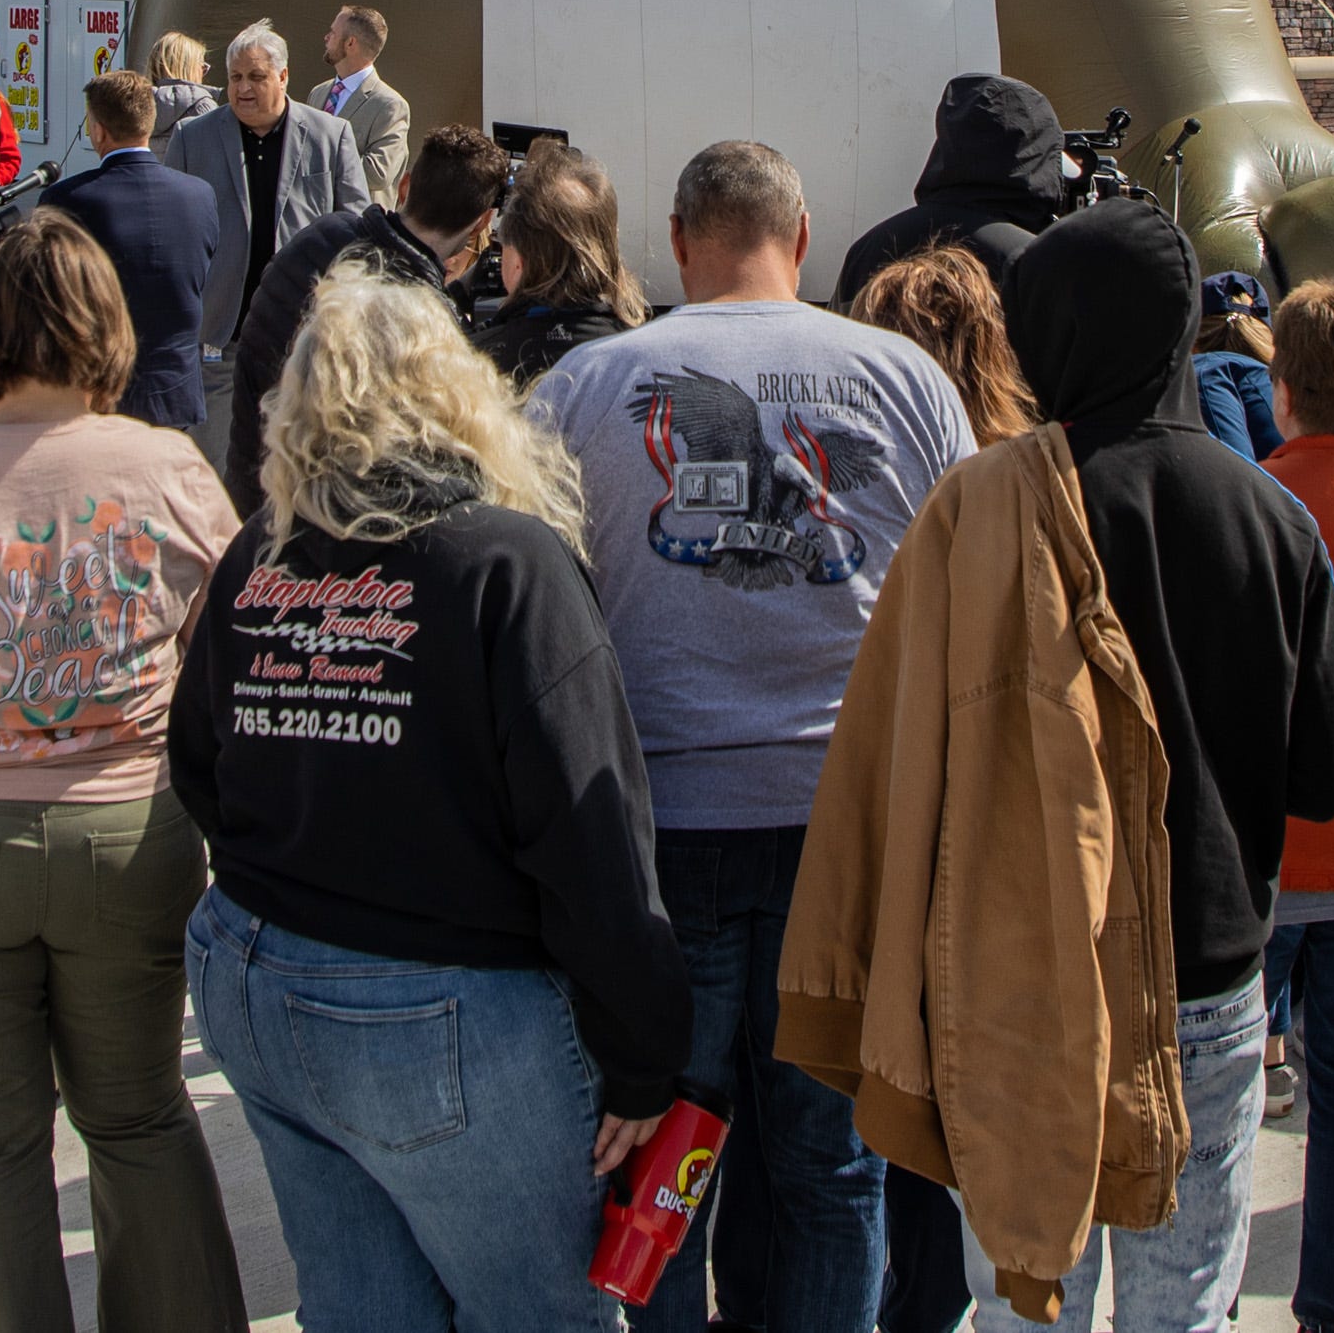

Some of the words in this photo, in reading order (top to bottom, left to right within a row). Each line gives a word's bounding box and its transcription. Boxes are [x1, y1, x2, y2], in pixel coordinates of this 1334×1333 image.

[9, 7, 39, 30] LARGE
[87, 11, 119, 34] LARGE
[757, 372, 881, 409] BRICKLAYERS
[816, 407, 860, 421] LOCAL
[722, 523, 818, 562] UNITED
[46, 598, 71, 621] as
[81, 596, 98, 612] a
[234, 565, 414, 624] Stapleton
[25, 616, 115, 663] GEORGIA
[317, 608, 419, 650] Trucking
[261, 651, 303, 679] Snow
[279, 683, 309, 698] Sand
[313, 684, 349, 700] Gravel
[358, 687, 413, 707] Asphalt
[233, 706, 402, 746] 765.220.2100
